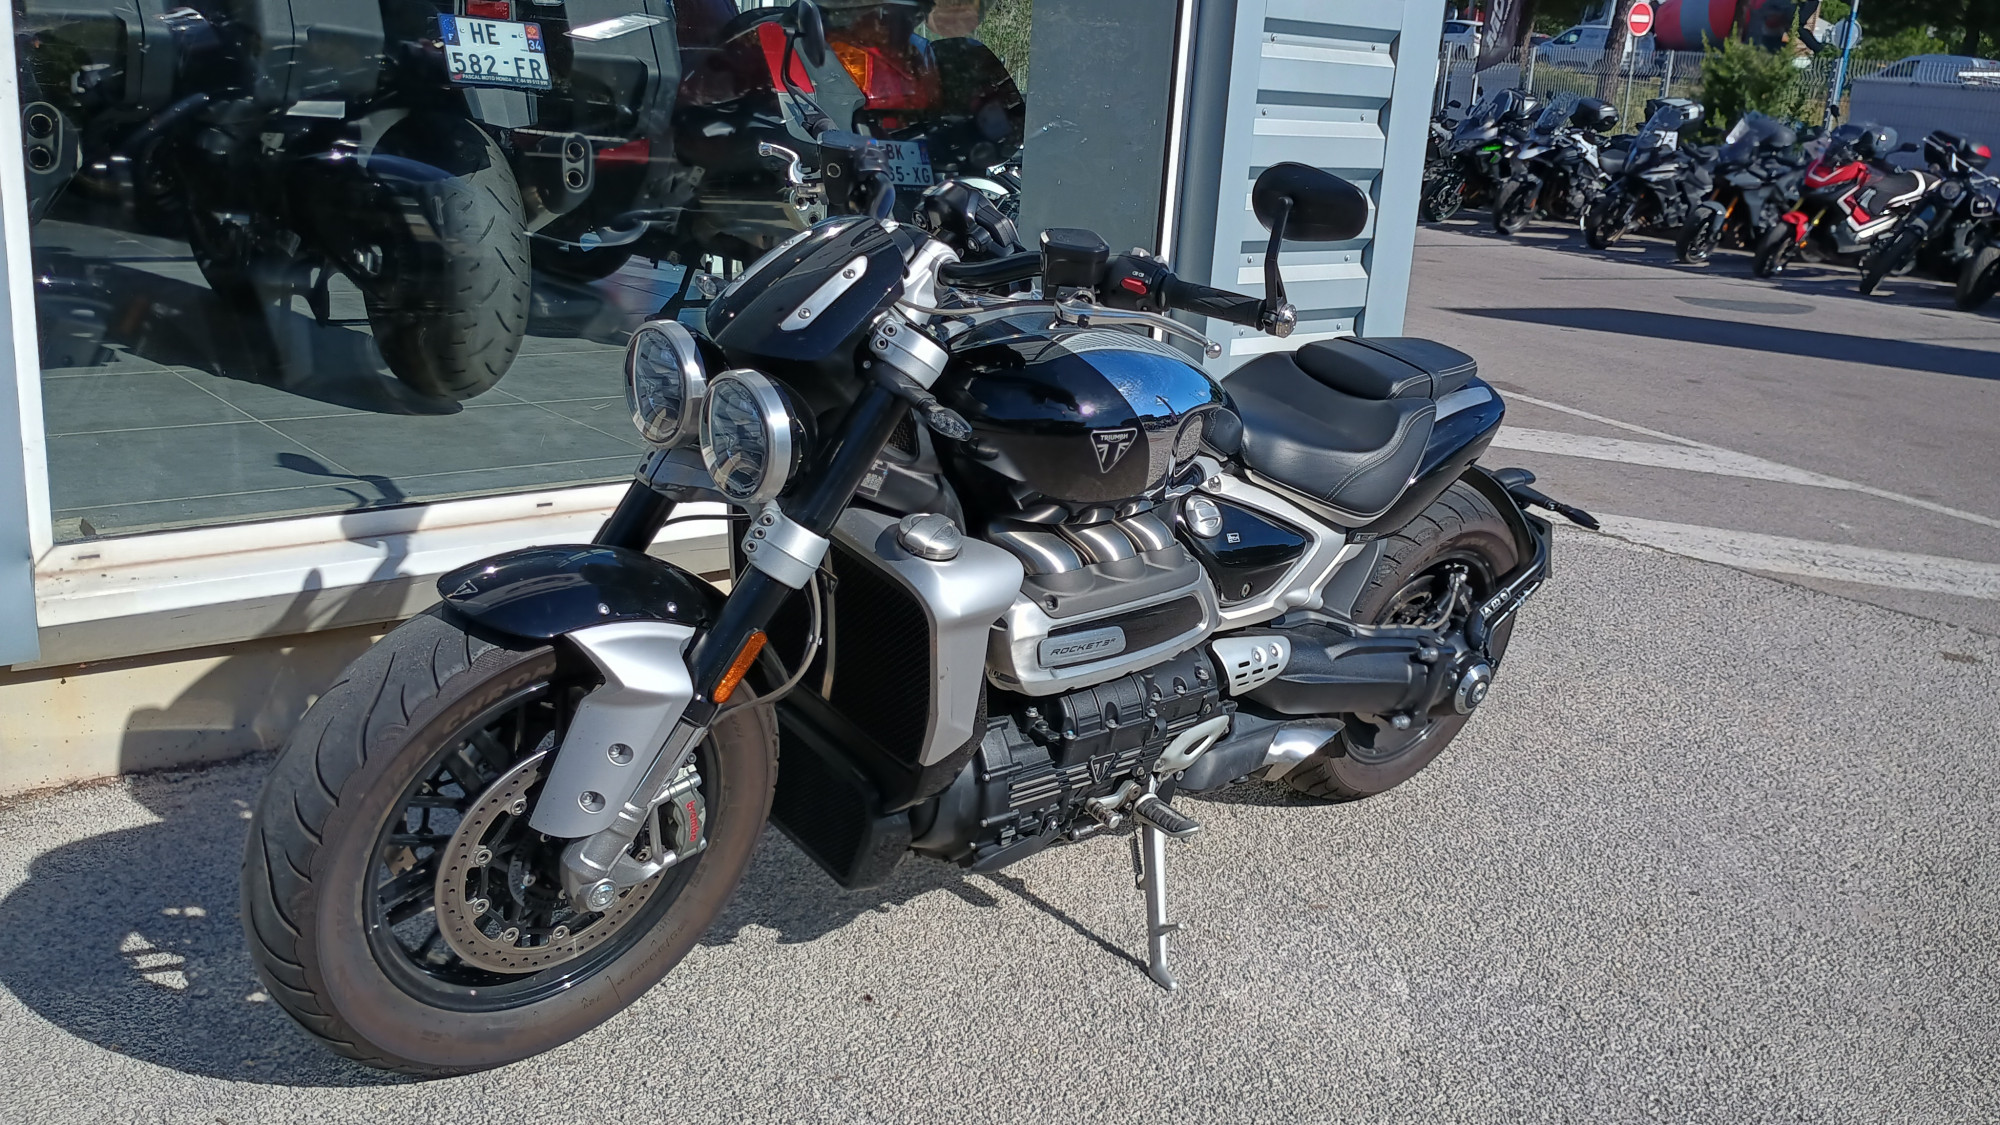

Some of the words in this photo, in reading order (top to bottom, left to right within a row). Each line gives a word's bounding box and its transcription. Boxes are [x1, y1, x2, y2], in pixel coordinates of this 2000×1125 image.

[469, 22, 500, 46] HE
[528, 39, 542, 51] 34
[452, 52, 543, 80] 582-FR
[886, 144, 904, 160] BK
[1100, 433, 1129, 442] TRIUMPH
[685, 800, 700, 842] brembo
